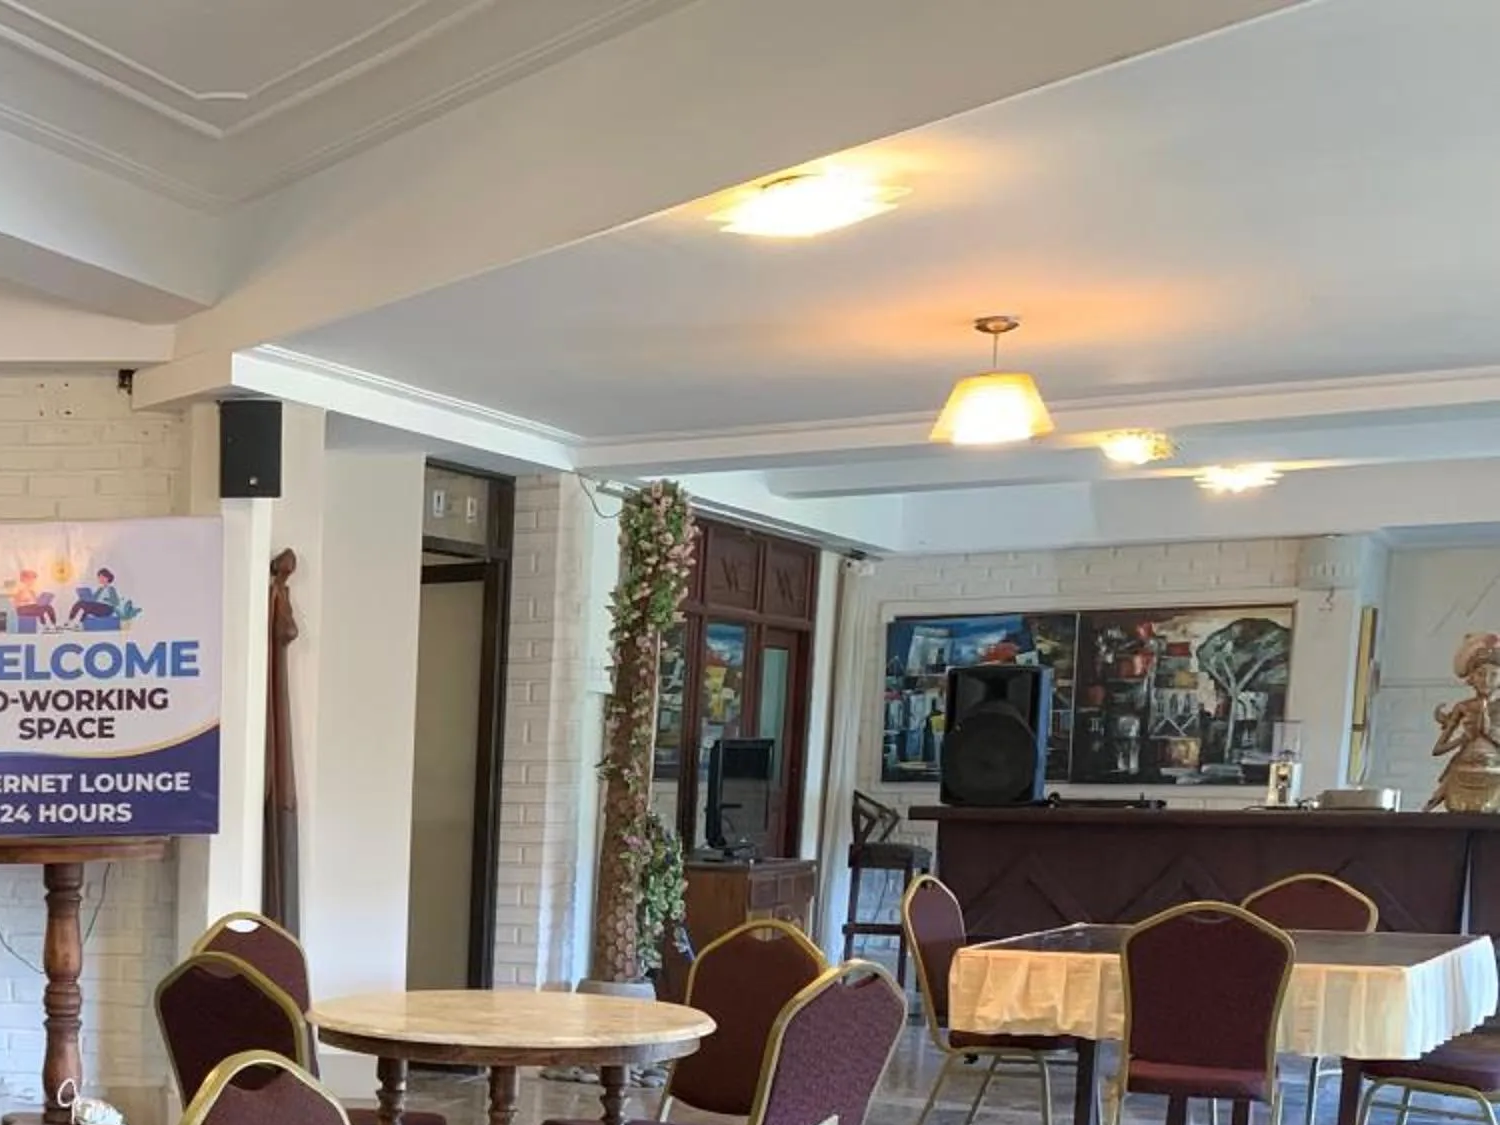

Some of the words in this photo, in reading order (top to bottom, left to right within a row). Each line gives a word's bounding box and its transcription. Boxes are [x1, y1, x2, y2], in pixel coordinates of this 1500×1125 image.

[19, 717, 115, 740] SPACE
[80, 772, 191, 792] LOUNGE
[0, 804, 31, 823] 24
[39, 803, 132, 822] HOURS
